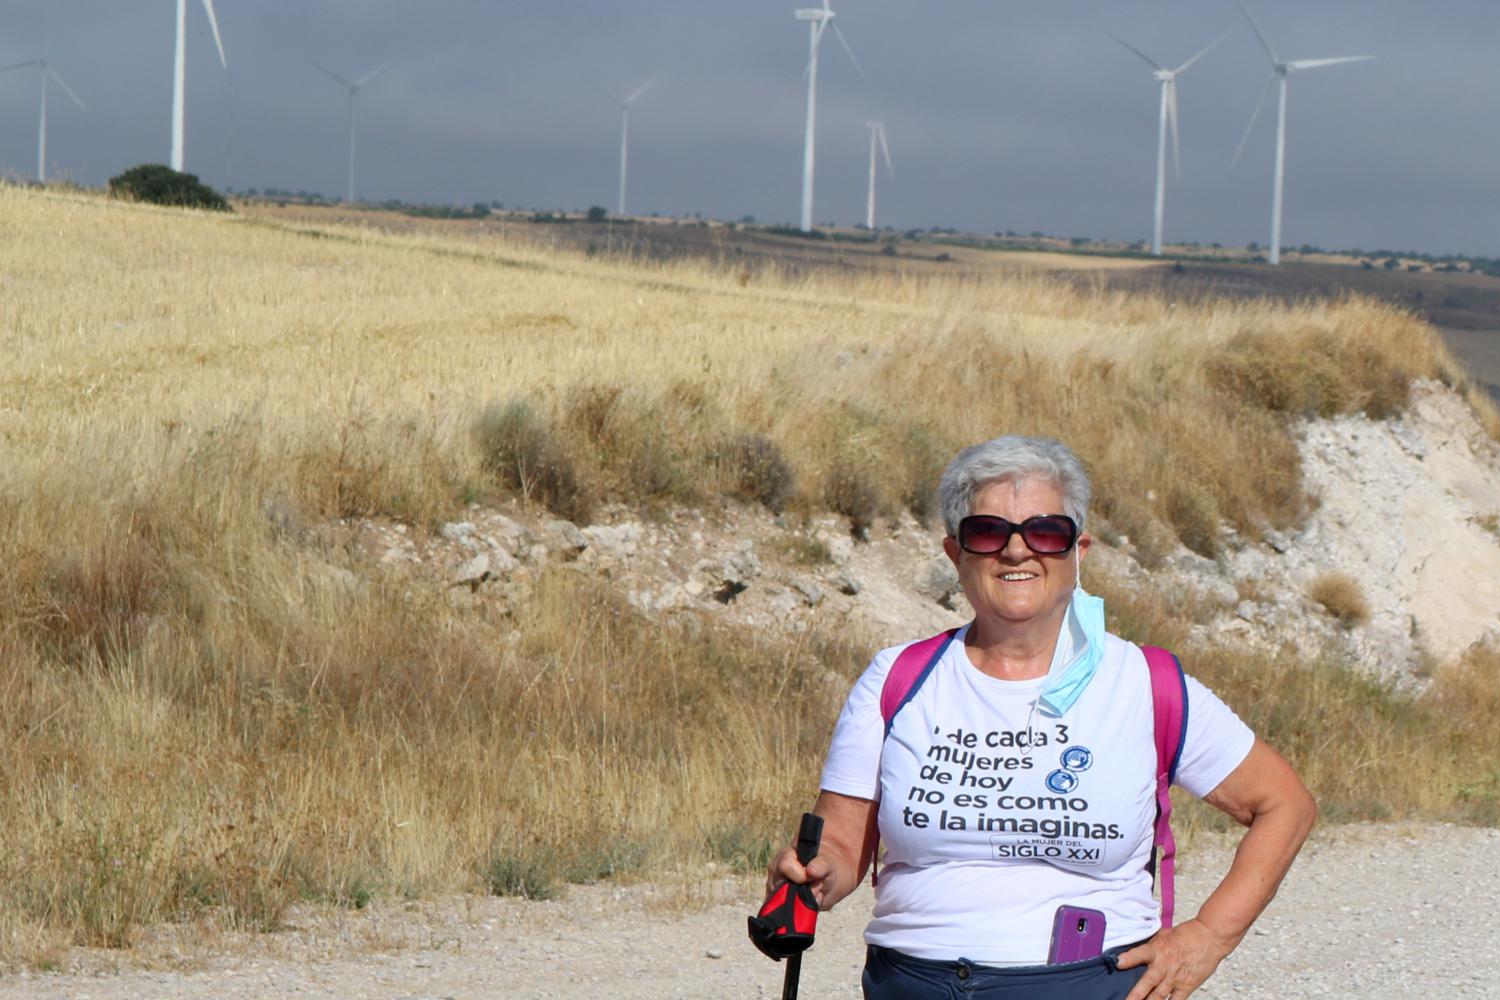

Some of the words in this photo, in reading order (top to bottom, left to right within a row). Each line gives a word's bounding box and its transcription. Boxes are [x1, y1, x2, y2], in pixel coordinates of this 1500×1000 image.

[985, 726, 1048, 748] cada
[1055, 724, 1069, 744] 3
[926, 744, 1034, 771] mujeres
[919, 764, 952, 785] de
[960, 771, 1014, 792] hoy
[908, 785, 945, 805] no
[953, 793, 988, 809] es
[997, 794, 1089, 812] como
[902, 806, 930, 829] te
[940, 809, 967, 831] la
[978, 813, 1125, 841] imaginas.
[998, 845, 1062, 857] SIGLO
[1067, 848, 1100, 860] XXI
